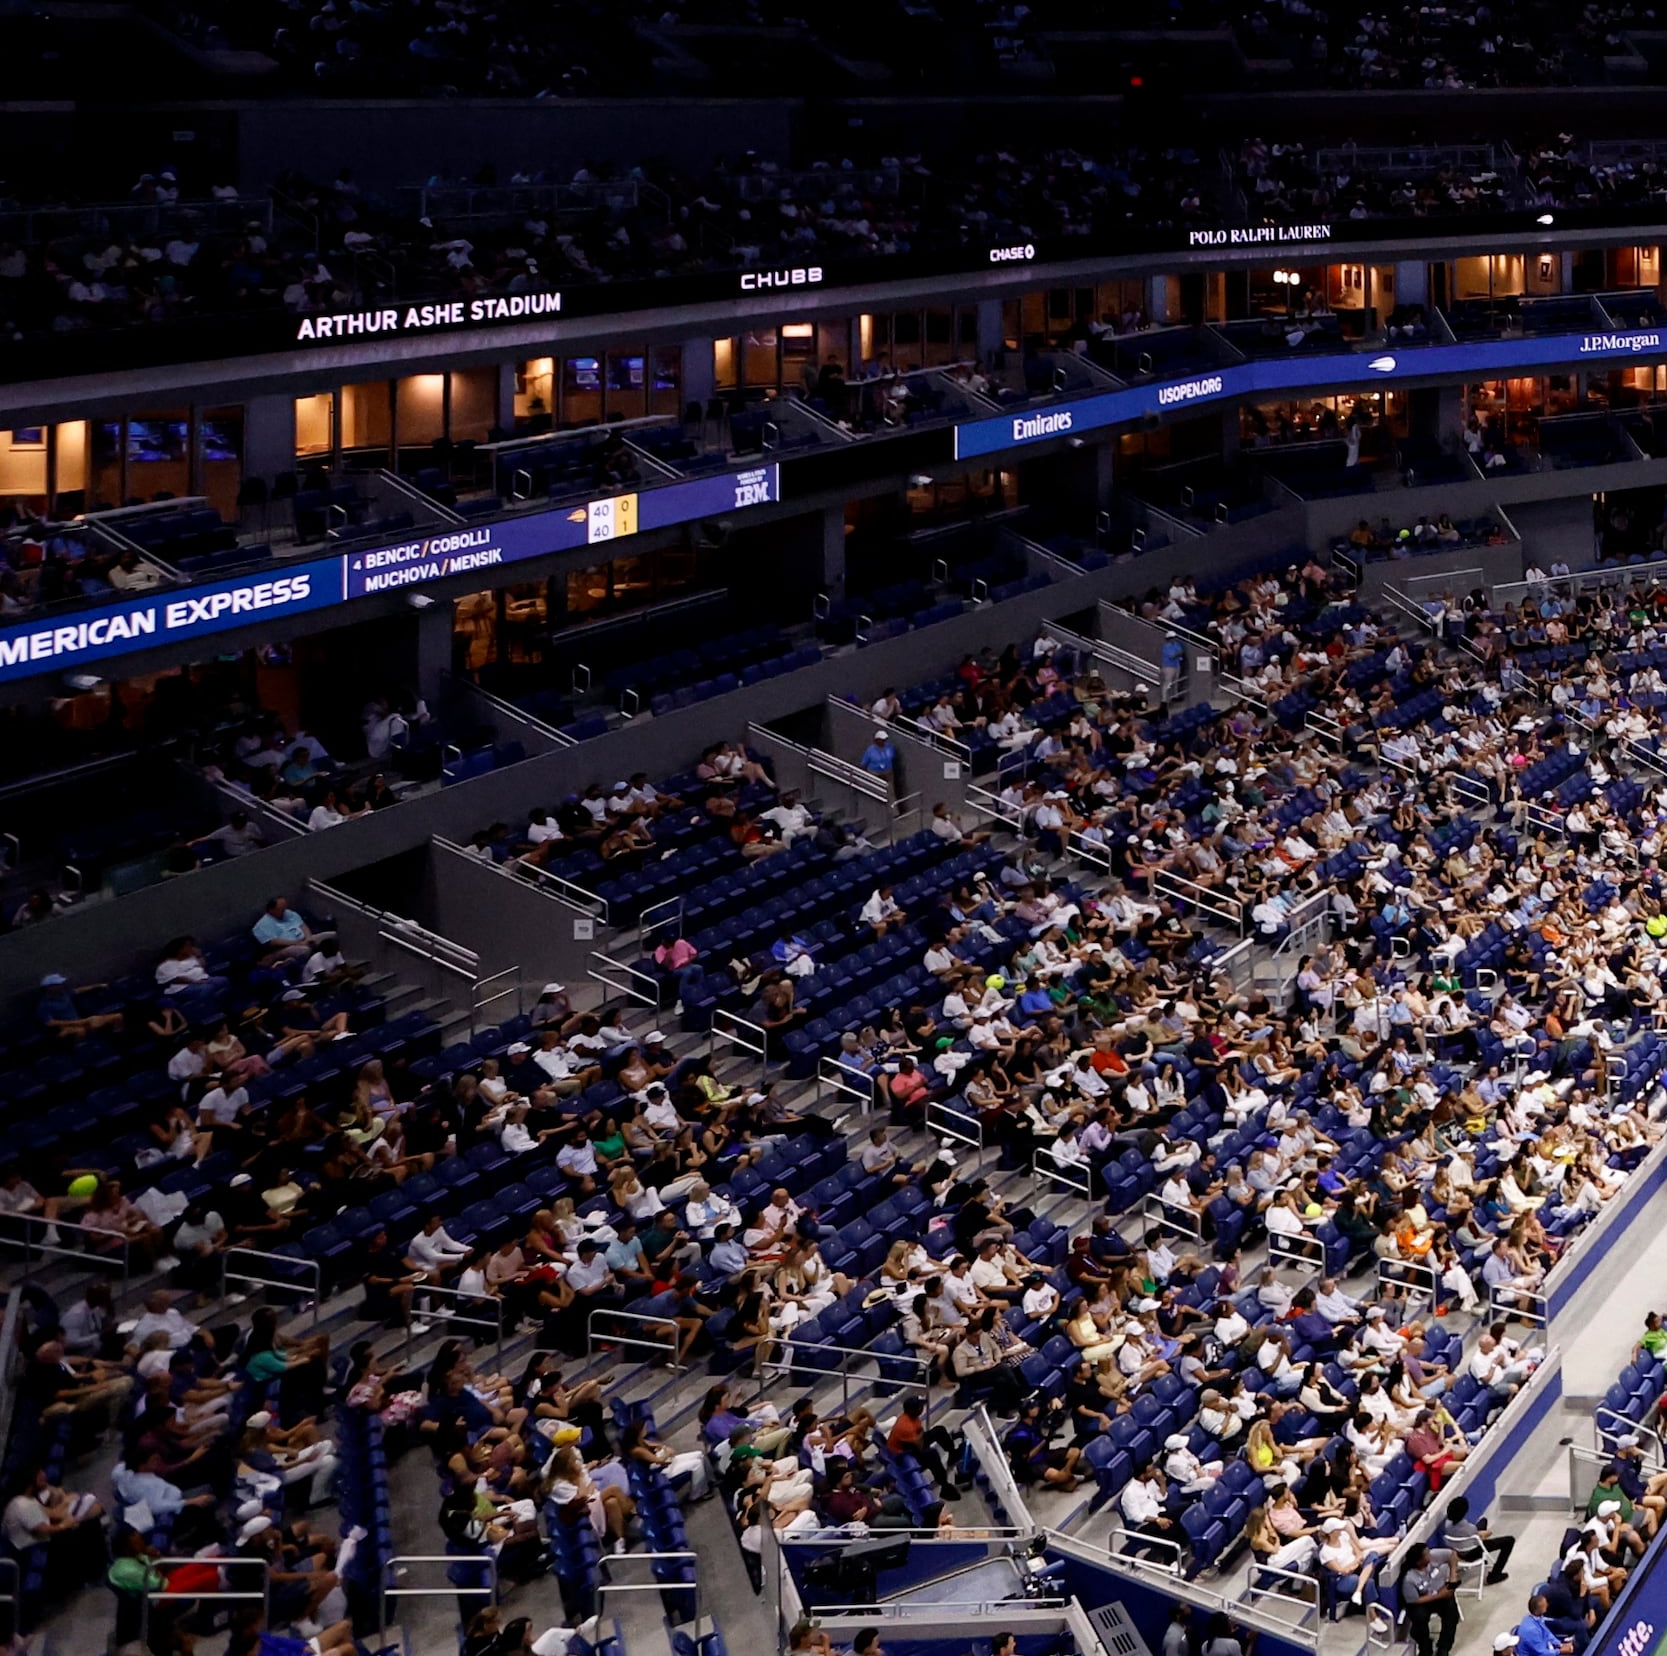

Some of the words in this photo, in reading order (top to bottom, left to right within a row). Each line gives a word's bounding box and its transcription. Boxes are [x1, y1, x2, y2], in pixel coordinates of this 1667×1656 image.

[1190, 231, 1226, 244] POLO
[1231, 228, 1274, 242] RALPH
[1279, 225, 1330, 240] LAUREN
[990, 247, 1024, 261] CHASE
[741, 267, 822, 289] CHUBB
[298, 310, 397, 339] ARTHUR
[404, 303, 464, 328] ASHE
[471, 293, 560, 320] STADIUM
[1580, 335, 1659, 351] J.P.Morgan
[1159, 377, 1222, 404] USOPEN.ORG
[1014, 412, 1072, 440] Emirates
[734, 481, 771, 508] IBM
[593, 504, 609, 517] 40
[621, 500, 630, 512] 0
[593, 525, 609, 537] 40
[167, 575, 310, 628] EXPRESS
